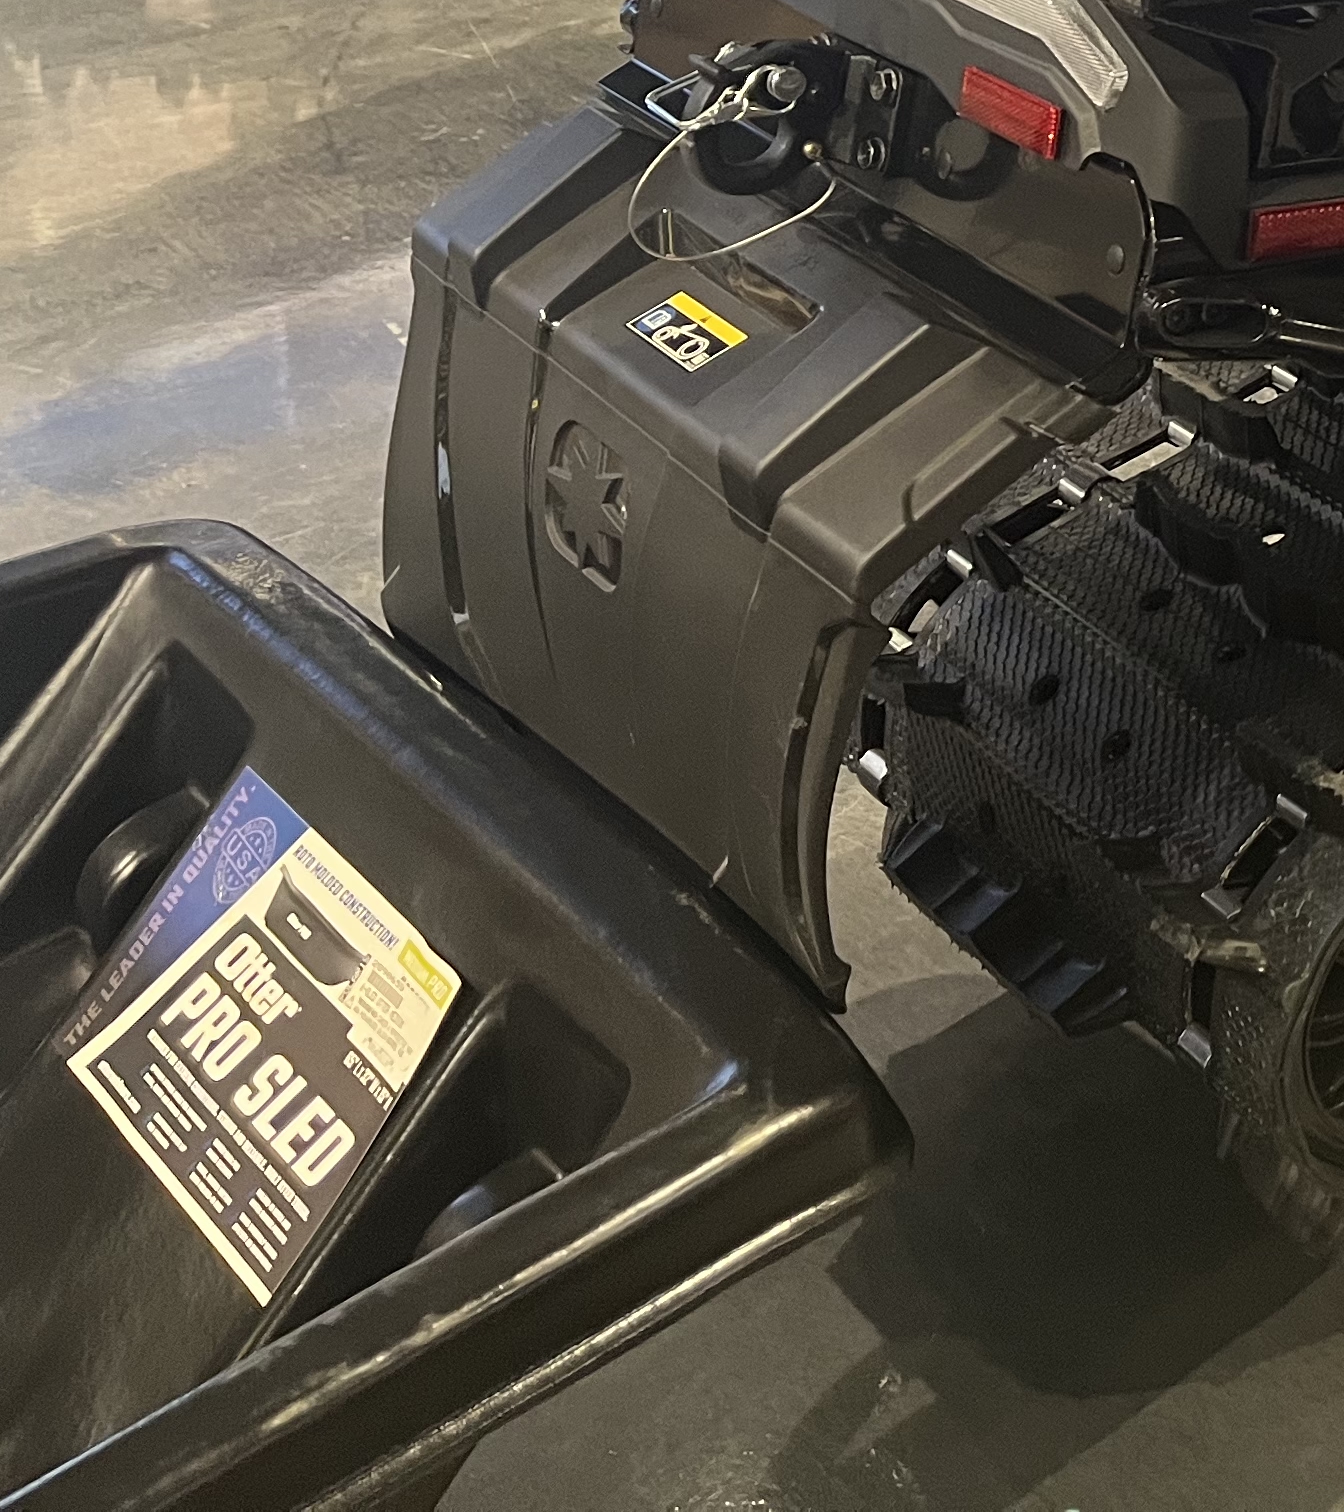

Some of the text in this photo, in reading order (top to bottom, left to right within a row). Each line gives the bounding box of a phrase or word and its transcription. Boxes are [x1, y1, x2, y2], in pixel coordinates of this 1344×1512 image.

[227, 834, 260, 882] USA
[293, 845, 314, 868] ROTO
[310, 861, 343, 890] MOLDED
[339, 889, 400, 951] CONSTRUCTION!
[63, 1001, 102, 1045] THE
[100, 912, 165, 1002] LEADER
[161, 884, 184, 915] IN
[214, 932, 300, 1024] Otter
[160, 971, 263, 1082] PRO
[233, 1053, 356, 1186] SLED
